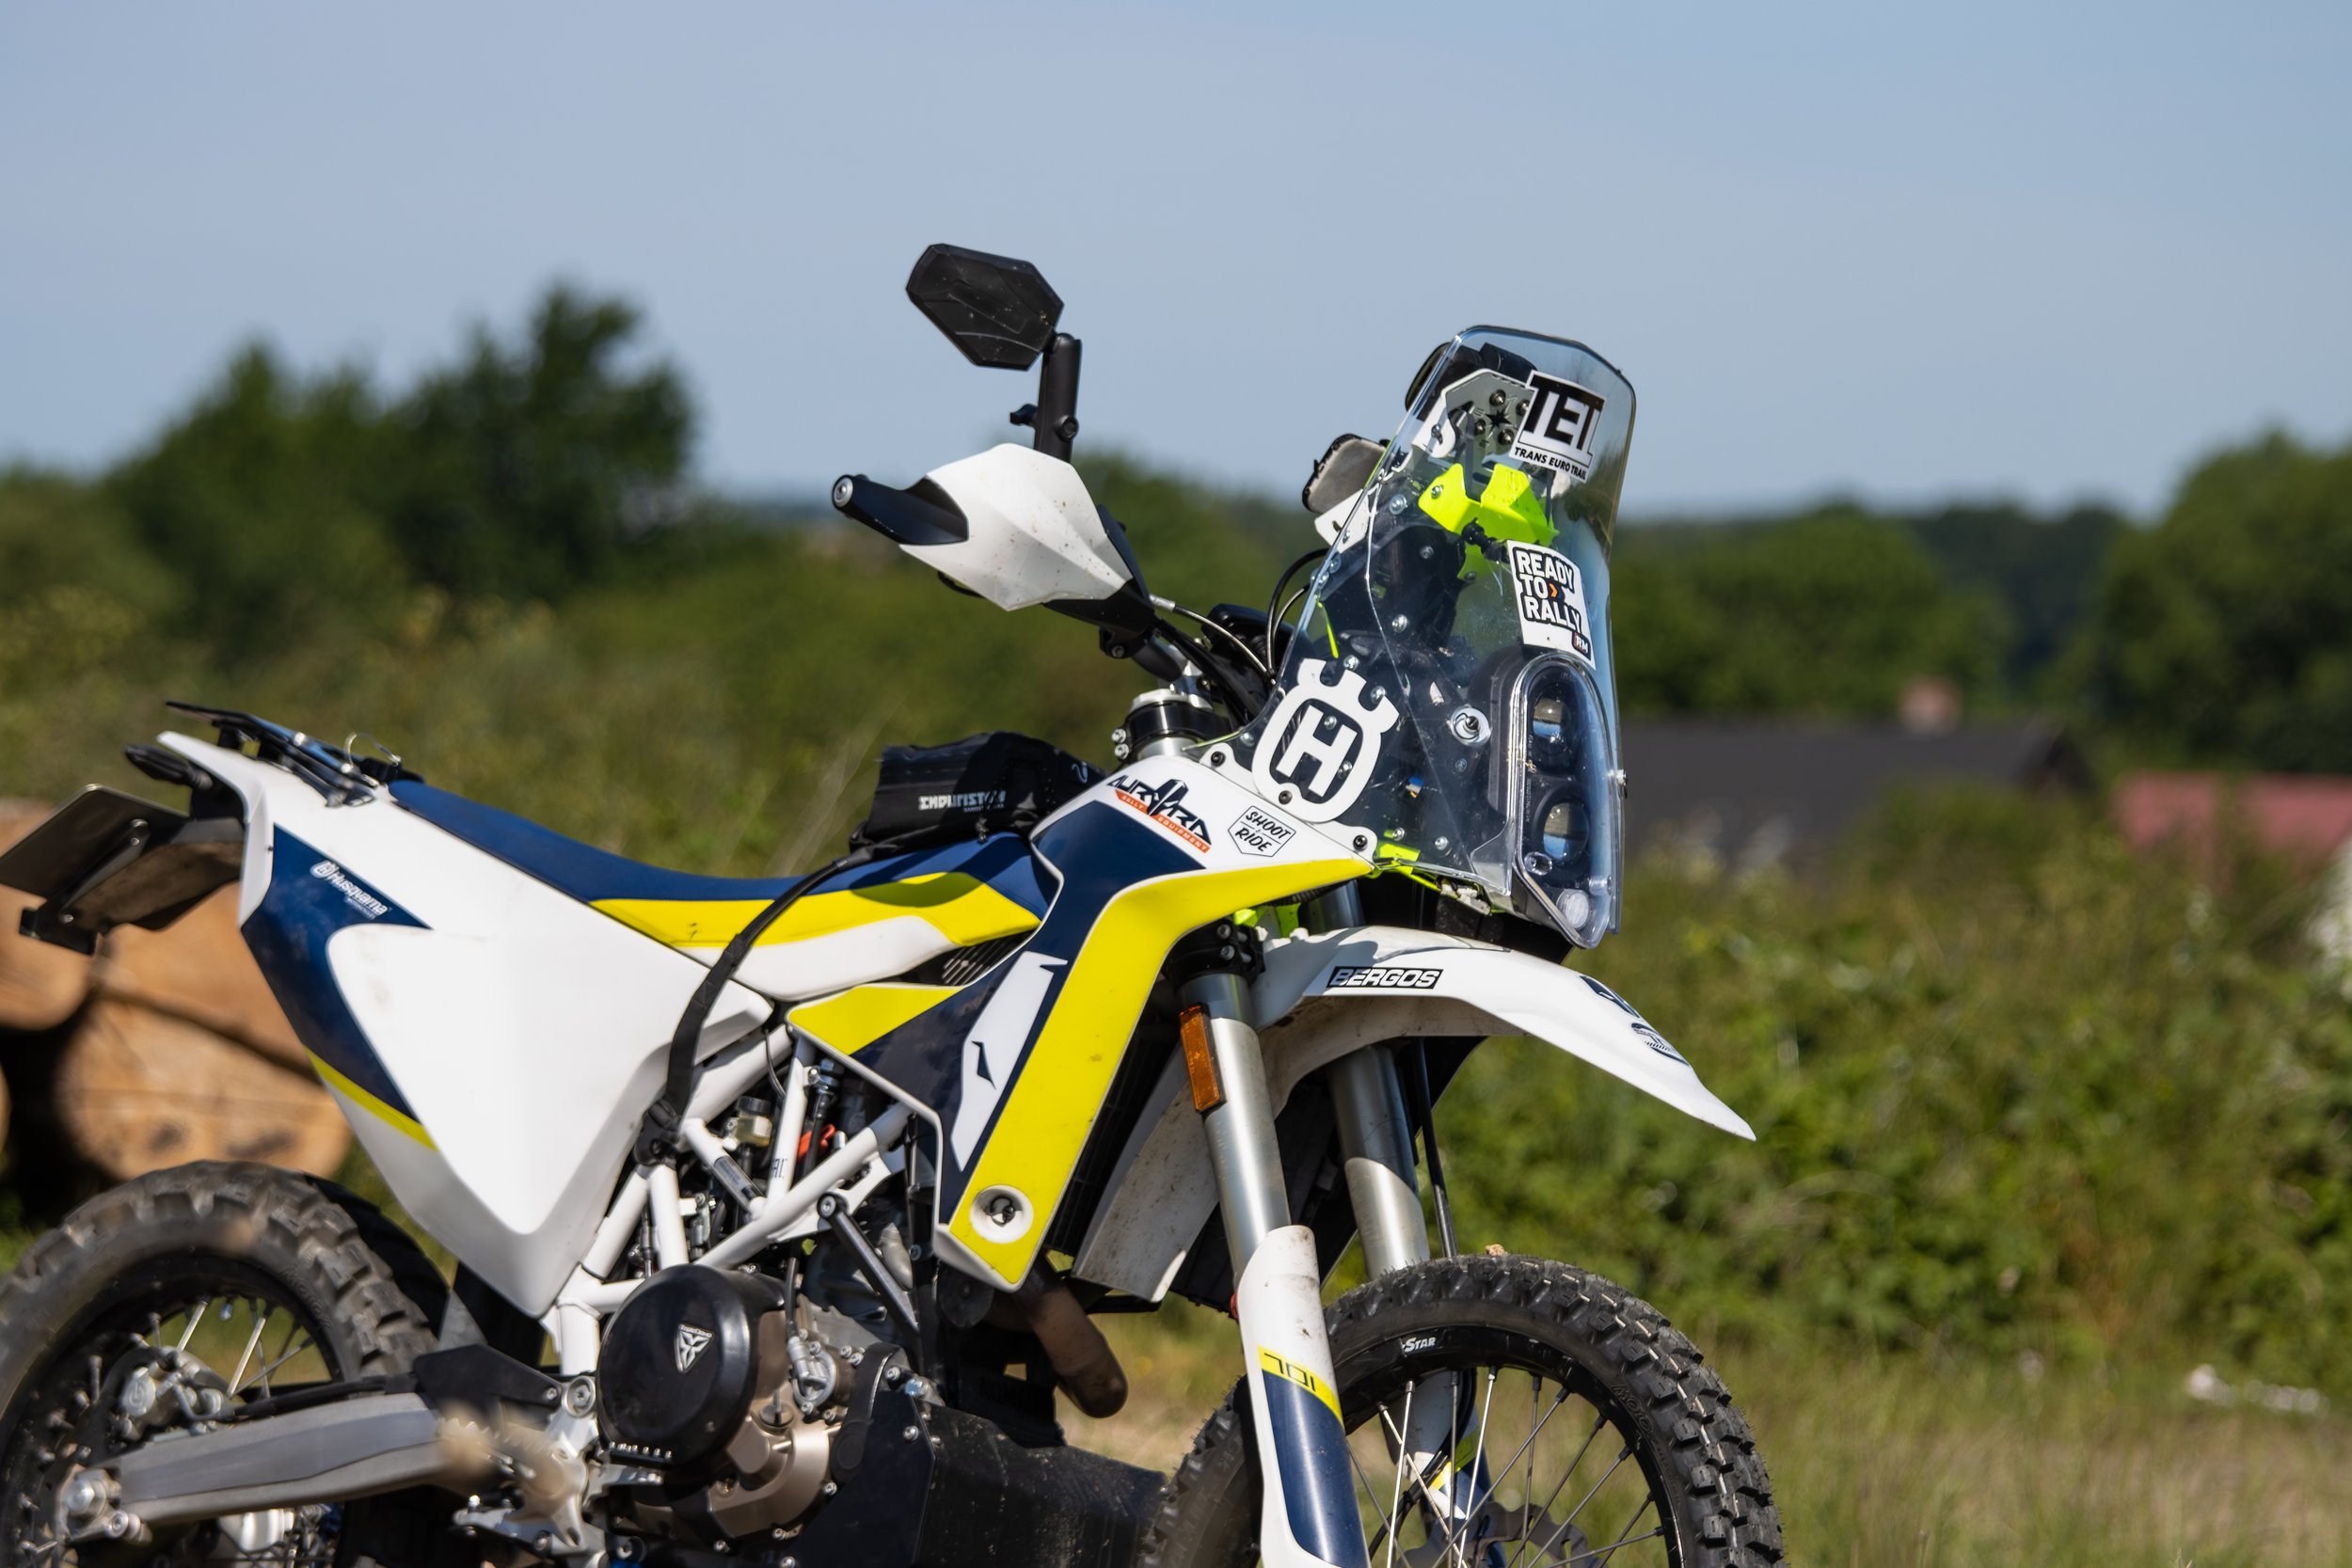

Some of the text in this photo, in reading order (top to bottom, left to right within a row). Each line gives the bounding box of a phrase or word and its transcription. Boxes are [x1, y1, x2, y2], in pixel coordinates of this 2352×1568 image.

[1522, 374, 1605, 451] TET
[1514, 447, 1587, 481] TRANS EURO TRAIL
[1516, 549, 1574, 590] READY
[1519, 573, 1549, 599] TO
[1523, 595, 1581, 633] RALLY
[1157, 815, 1208, 852] EQUIPMENT
[1234, 827, 1272, 852] RIDE
[1246, 811, 1292, 839] SHOOT
[326, 870, 389, 916] Husqvarna
[1328, 967, 1440, 988] BERGOS
